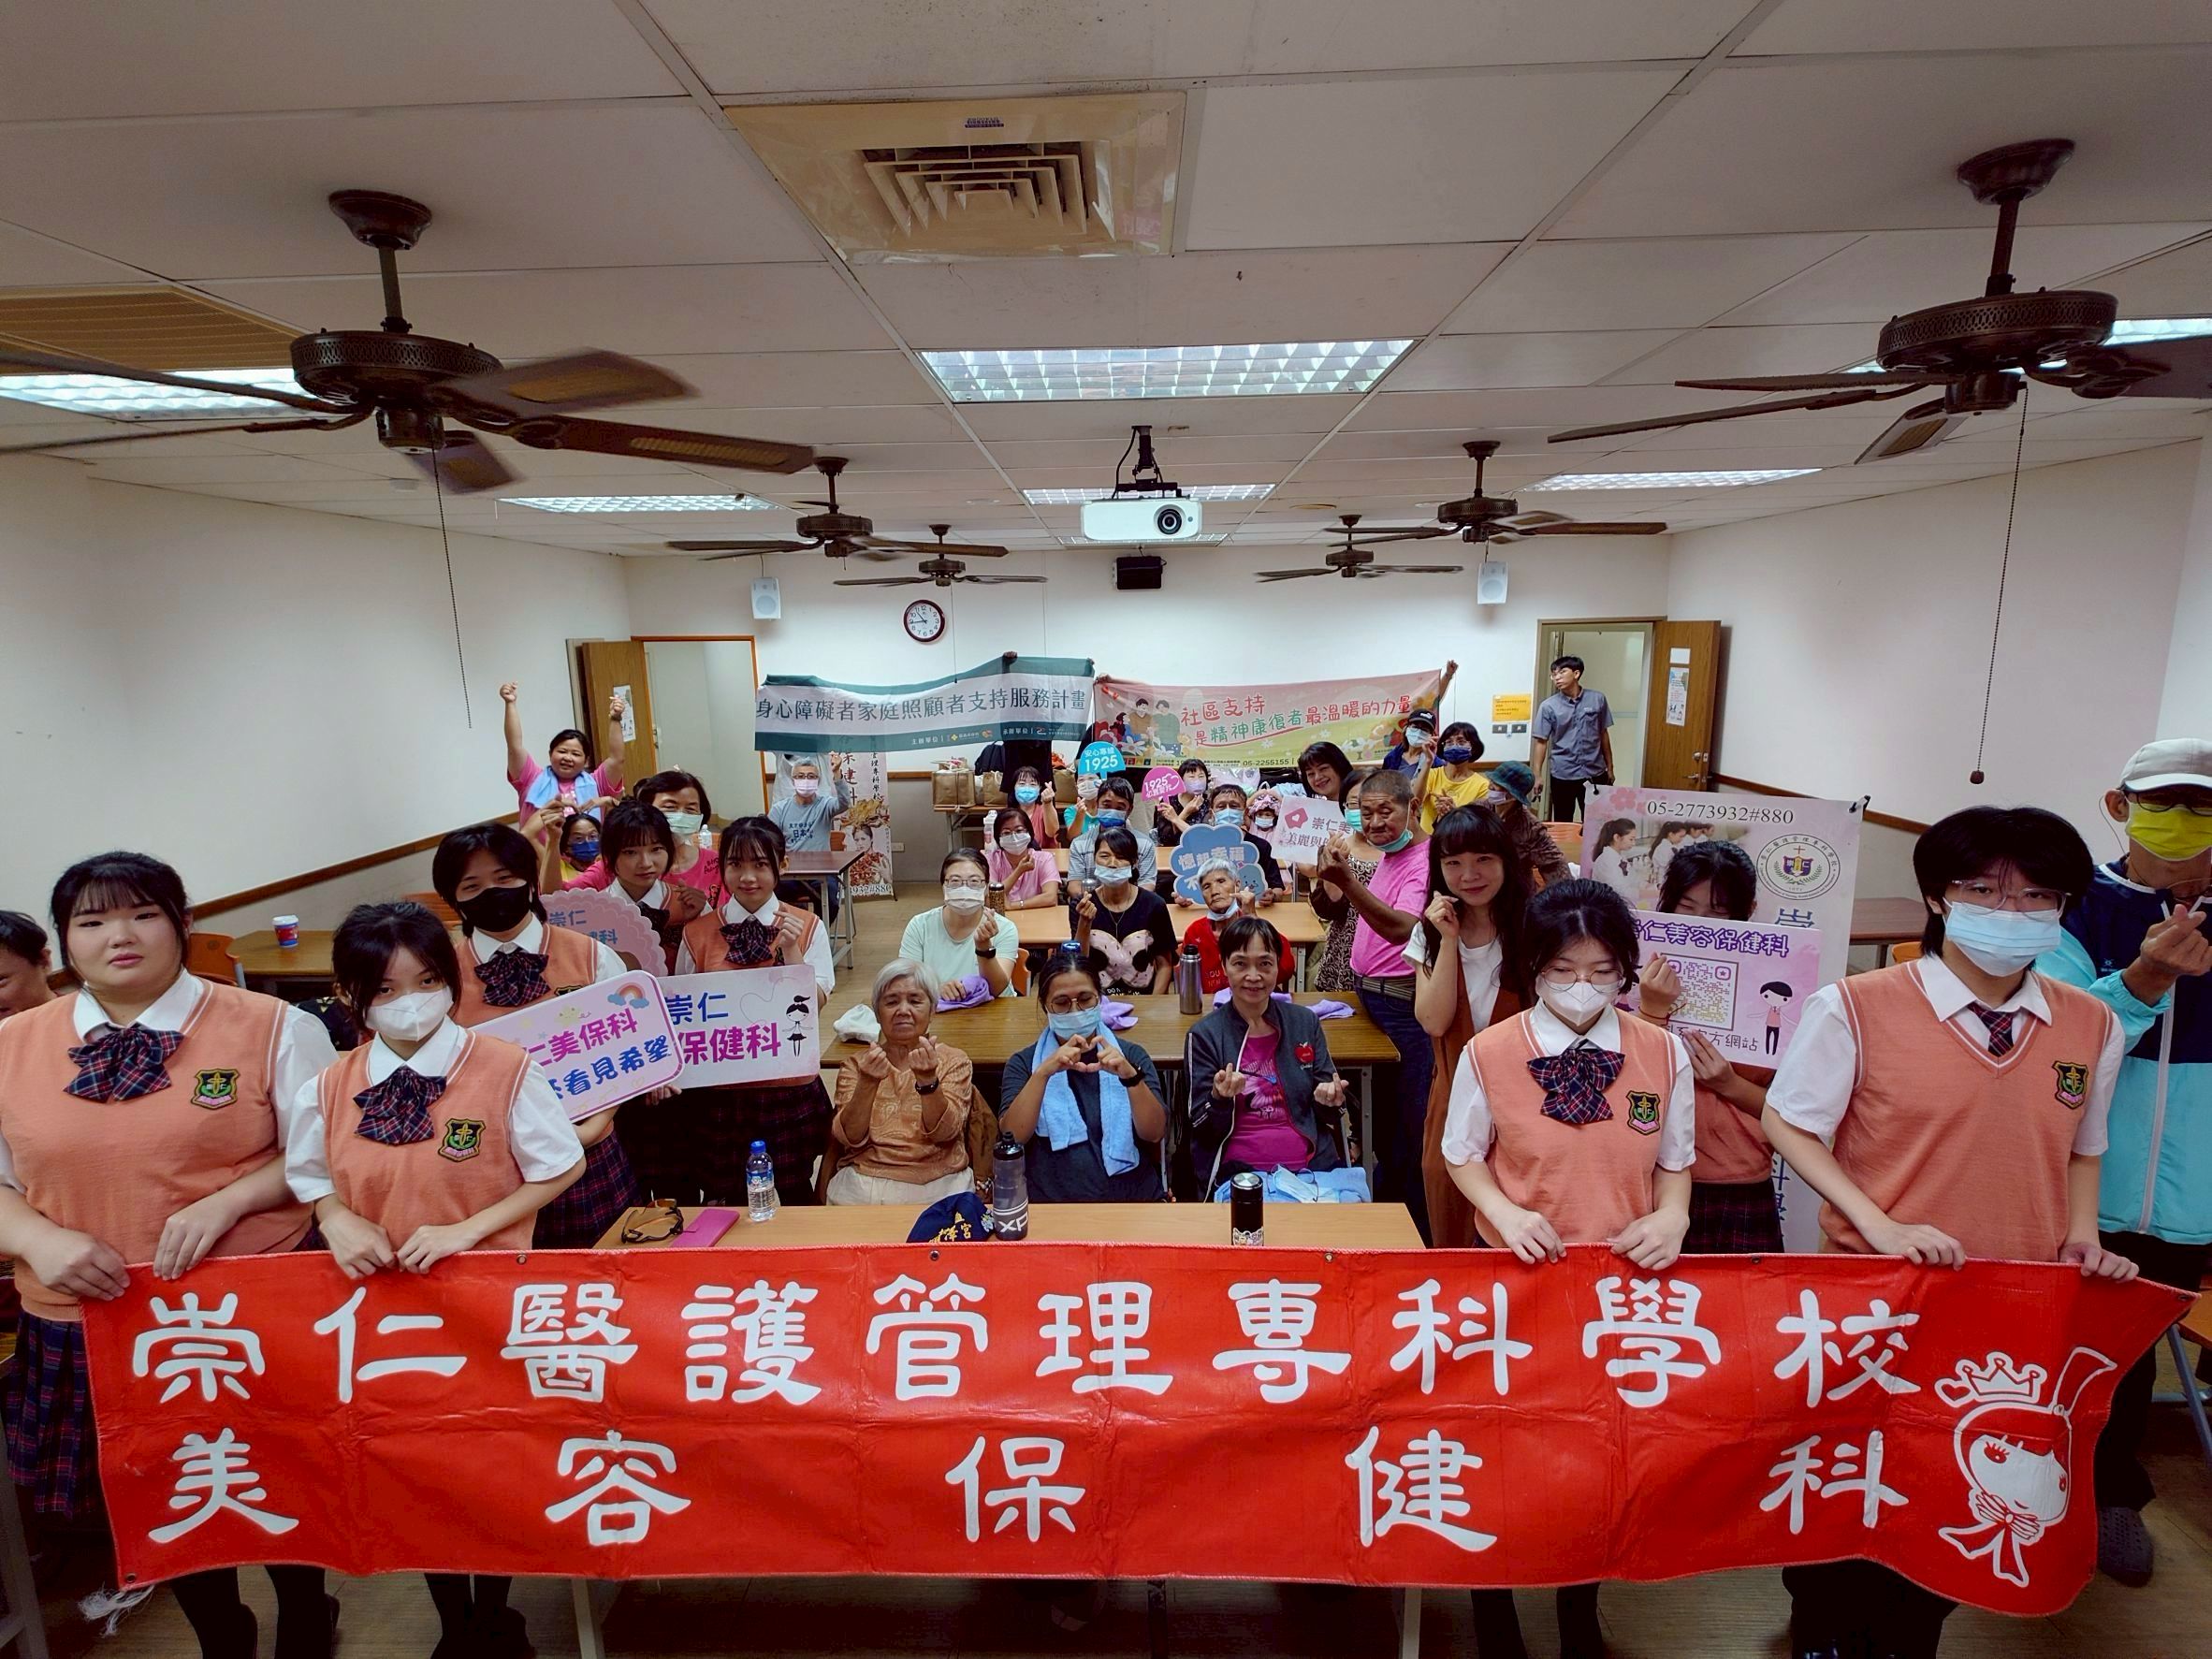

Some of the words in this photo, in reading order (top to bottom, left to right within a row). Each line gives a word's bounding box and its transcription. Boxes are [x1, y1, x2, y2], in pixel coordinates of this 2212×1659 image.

[756, 687, 1086, 721] 身心障礙者家庭照顧者支持服務計畫
[1181, 694, 1265, 726] 社區支持
[1085, 755, 1118, 772] 1925
[1144, 778, 1169, 793] 1925
[1647, 800, 1794, 824] 05-2773932#880
[549, 910, 587, 926] 崇仁
[1637, 919, 1789, 958] 仁美容保健科
[663, 992, 729, 1026] 崇仁
[677, 1022, 782, 1065] 保健科
[130, 1273, 1923, 1408] 崇仁醫護管理專科學校
[148, 1425, 1911, 1553] 美容保健科
